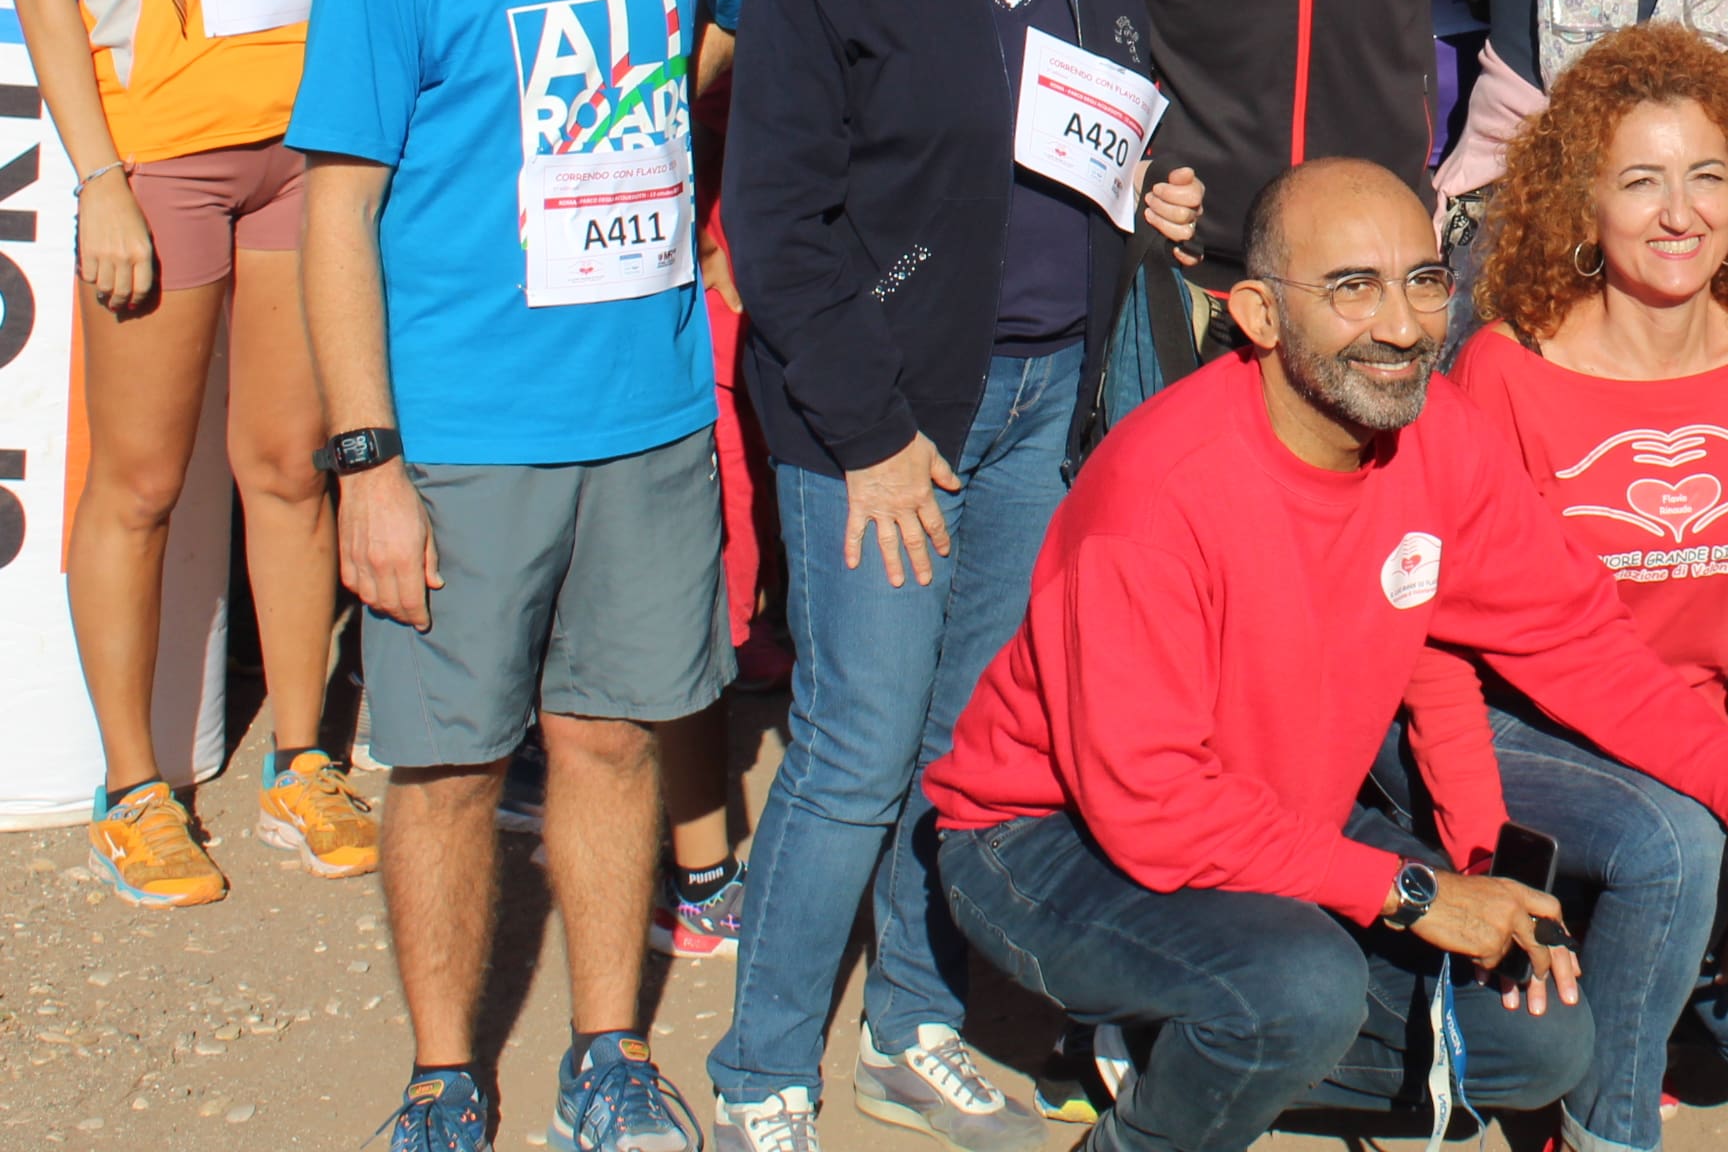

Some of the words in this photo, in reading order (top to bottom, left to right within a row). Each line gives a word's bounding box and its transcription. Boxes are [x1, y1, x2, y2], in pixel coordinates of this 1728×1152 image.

[1064, 113, 1129, 168] A420
[555, 167, 609, 185] CORRENDO
[612, 168, 633, 179] CON
[635, 163, 667, 177] FLAVIO
[584, 211, 666, 251] A411
[1645, 548, 1708, 568] GRANDE
[1672, 564, 1688, 577] di
[689, 866, 724, 885] PUMA
[1446, 1008, 1463, 1056] NOKIA
